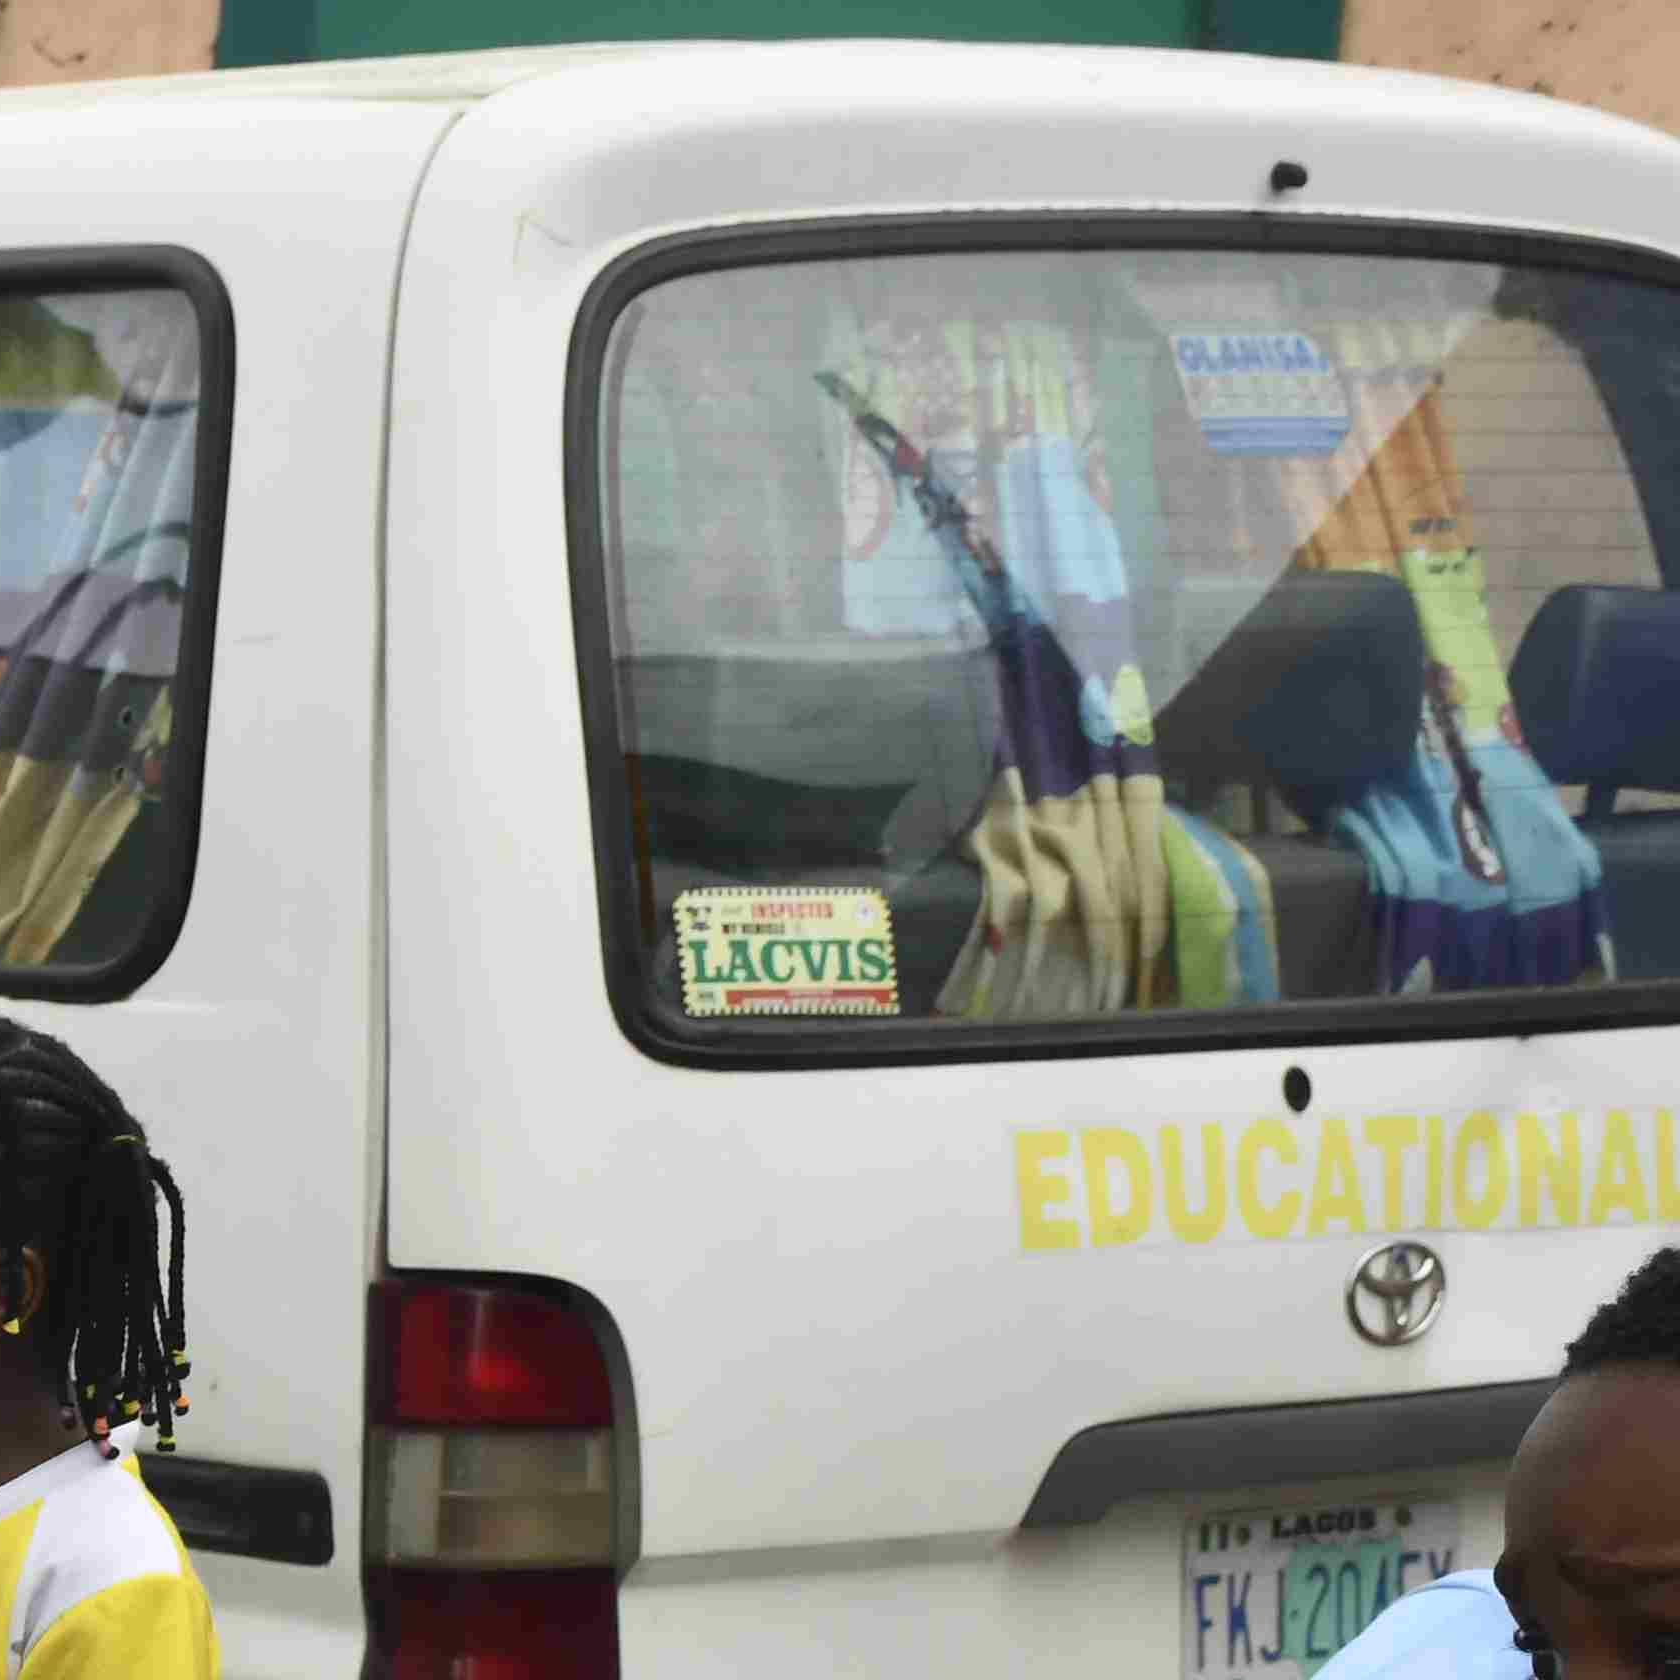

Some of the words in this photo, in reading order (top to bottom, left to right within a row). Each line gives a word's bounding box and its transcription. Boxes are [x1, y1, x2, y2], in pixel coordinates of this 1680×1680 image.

[688, 938, 889, 983] LACVIS
[1012, 1106, 1680, 1252] EDUCATIONAL
[1273, 1508, 1376, 1539] LAGOS
